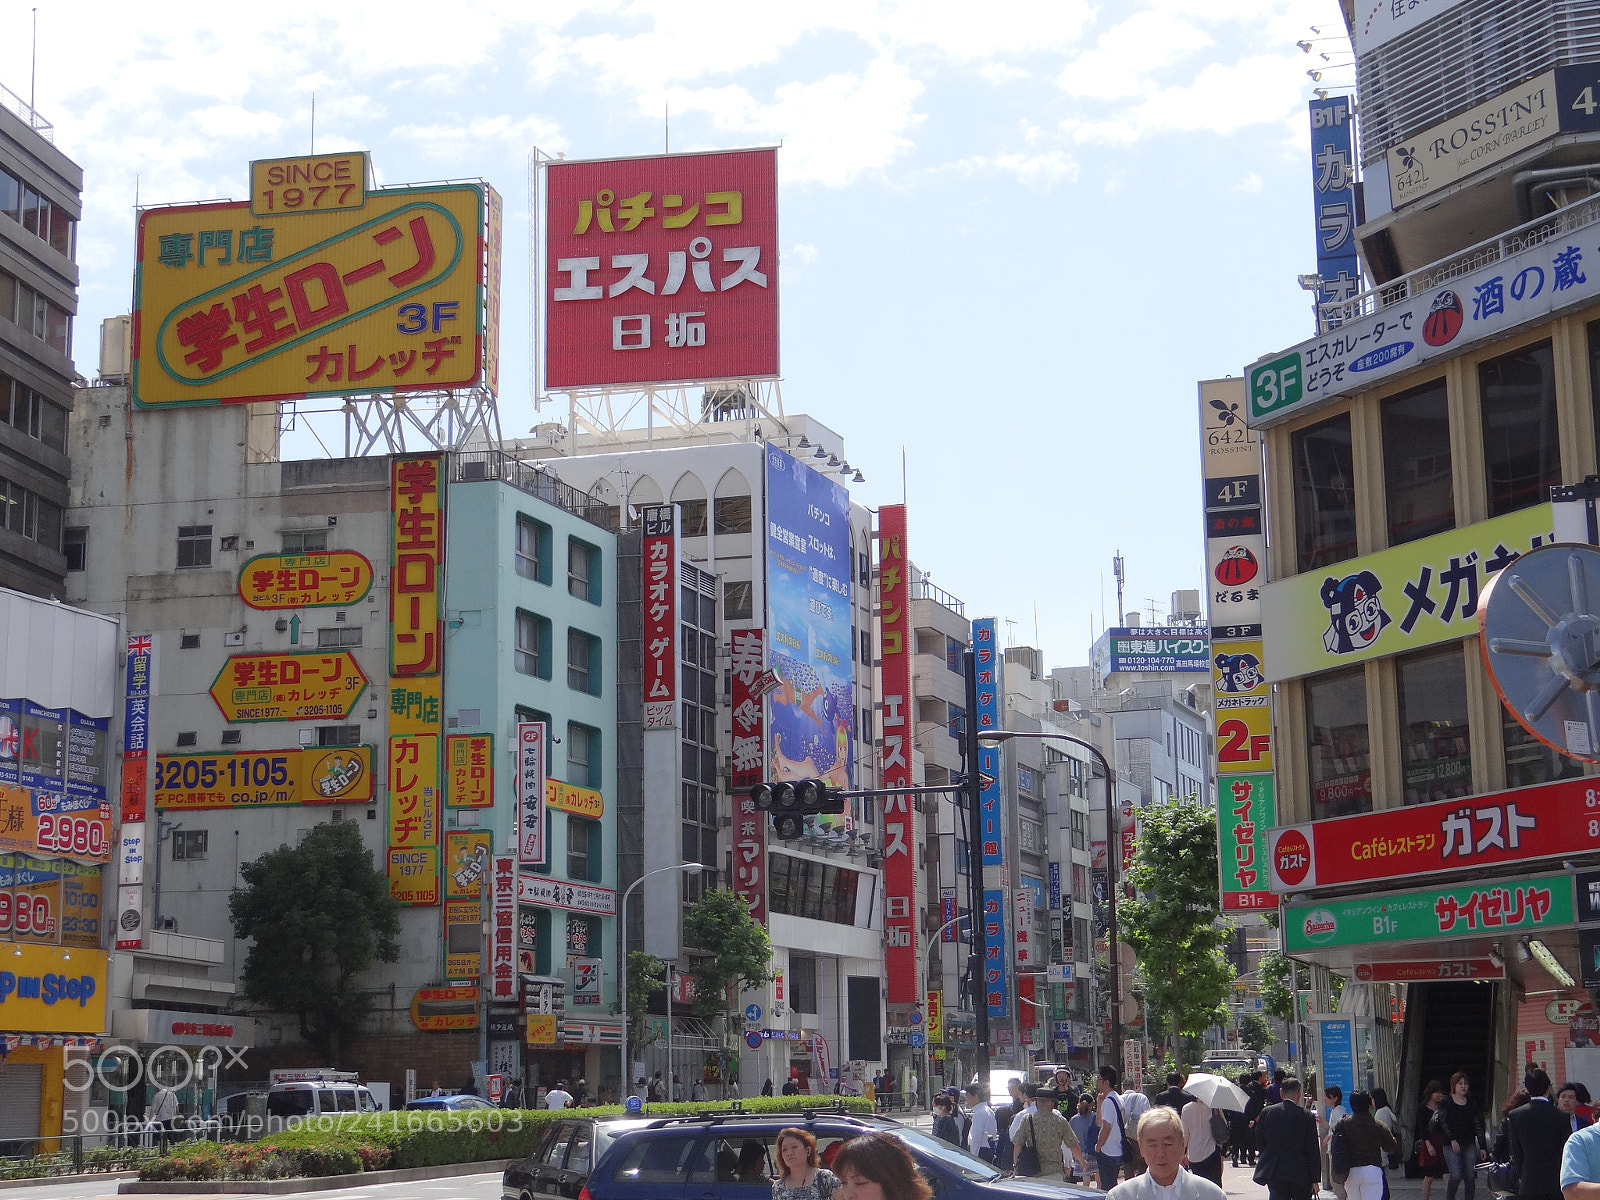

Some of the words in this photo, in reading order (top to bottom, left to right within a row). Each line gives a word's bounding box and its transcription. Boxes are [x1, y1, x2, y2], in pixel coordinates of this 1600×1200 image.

[1312, 106, 1346, 129] B1F
[1429, 88, 1547, 160] ROSSINI
[267, 160, 350, 186] SINCE
[263, 184, 355, 210] 1977
[573, 189, 743, 235] パチンコ
[158, 226, 274, 267] 専門店
[554, 236, 768, 302] エスパス
[1473, 246, 1586, 321] 酒の蔵
[176, 216, 435, 374] 学生ローン
[397, 302, 459, 334] 3F
[612, 311, 706, 351] 日拓
[1305, 311, 1412, 368] エスカレーターで
[1256, 364, 1297, 408] 3F
[1306, 362, 1345, 393] どうぞ
[1218, 480, 1248, 503] 4F
[646, 522, 671, 535] ビル
[808, 504, 830, 526] パチンコ
[284, 558, 326, 568] 専門店
[397, 460, 436, 674] 学生ローン
[252, 566, 360, 592] 学生ローン
[882, 534, 902, 654] パチンコ
[1215, 589, 1259, 603] だるま
[650, 541, 669, 697] カラオケ・ゲーム
[1227, 626, 1250, 637] 3F
[132, 656, 147, 690] 留学
[233, 658, 342, 687] 学生ローン
[1127, 656, 1174, 664] 0120-104-770
[234, 690, 269, 703] 専門店
[345, 676, 359, 691] 3F
[31, 708, 60, 719] MANCHESTER
[304, 704, 343, 715] 3205-1105
[391, 688, 439, 724] 専門店
[646, 704, 672, 715] ビッグ
[131, 698, 146, 750] 英会話
[646, 716, 672, 727] タイム
[1218, 719, 1269, 763] 2F
[471, 738, 487, 803] 学生ローン
[883, 695, 908, 857] エスパス
[1231, 780, 1257, 889] サイゼリヤ
[1351, 833, 1436, 860] Caféレストラン
[1442, 803, 1536, 859] ガスト
[391, 852, 428, 864] SINCE
[1280, 854, 1307, 869] ガスト
[1239, 893, 1263, 907] B1F
[1434, 887, 1552, 932] サイゼリヤ
[1373, 915, 1398, 935] B1F
[985, 900, 1003, 1006] カラオケ館
[1438, 962, 1478, 976] ガスト
[420, 989, 477, 1000] 学生ローン
